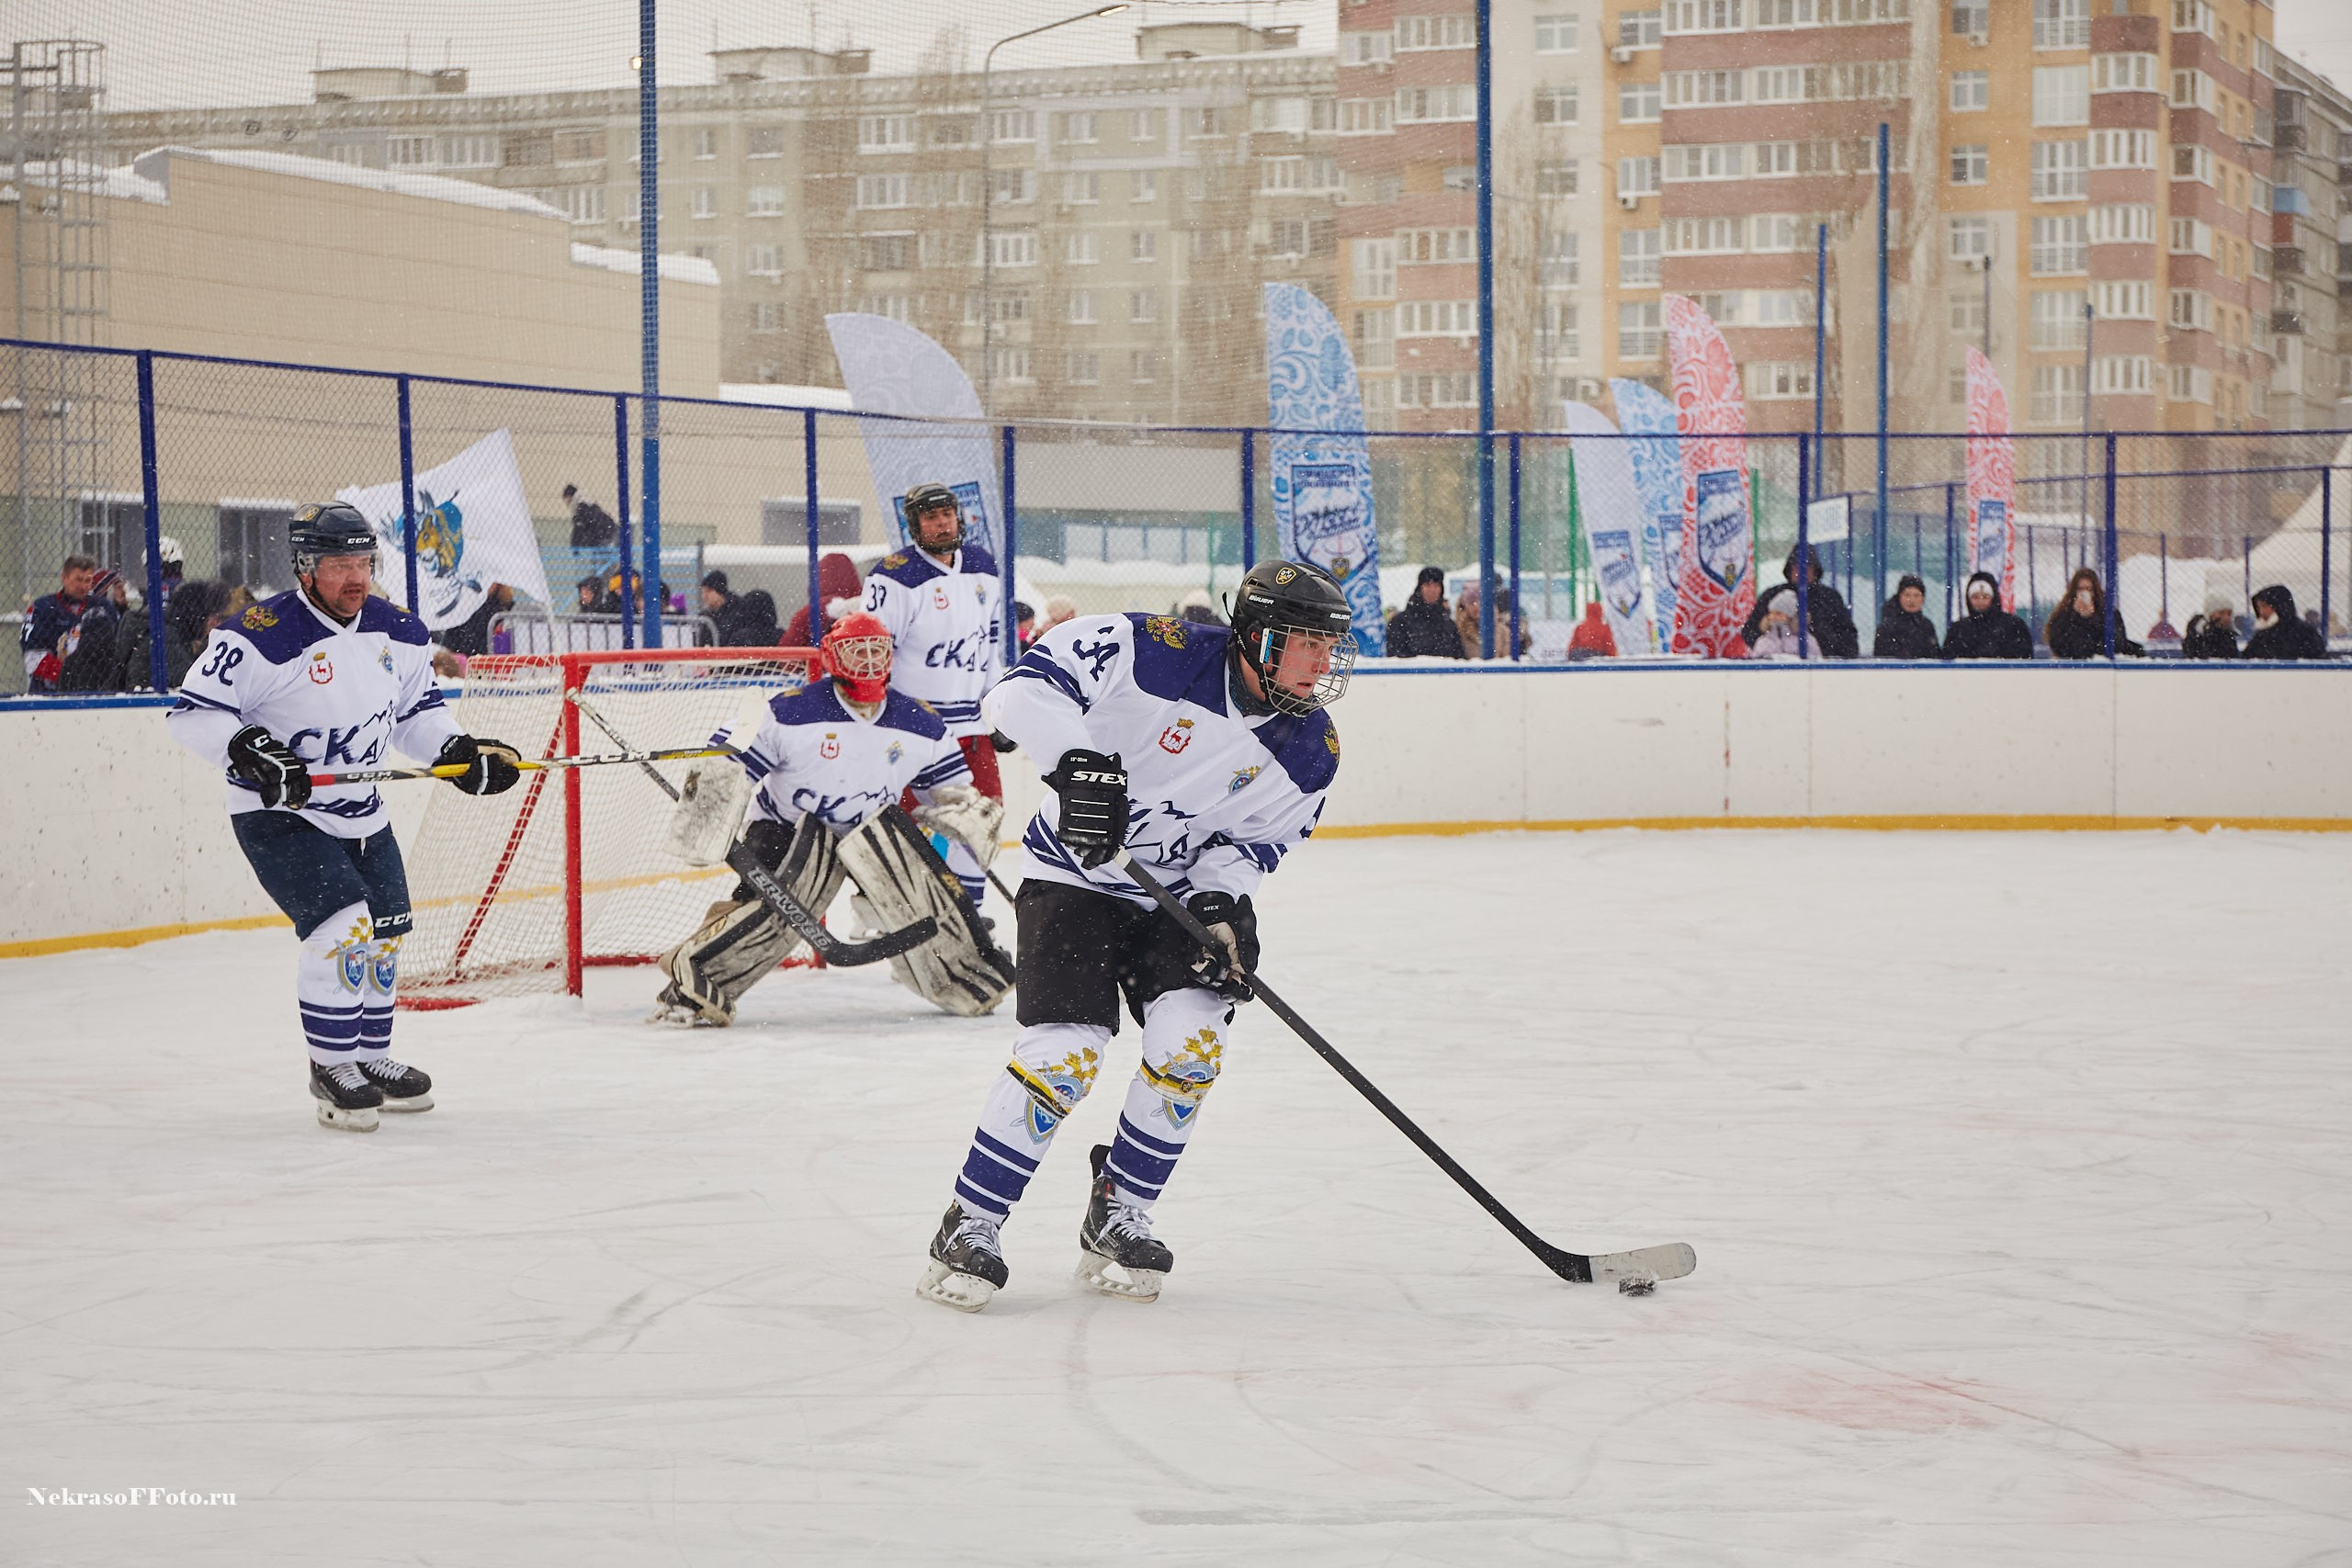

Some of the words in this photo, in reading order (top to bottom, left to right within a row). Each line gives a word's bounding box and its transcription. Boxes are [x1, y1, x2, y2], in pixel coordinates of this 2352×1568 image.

[201, 641, 243, 686] 38
[443, 736, 459, 754] CCM
[346, 771, 392, 780] CCM
[1070, 771, 1127, 786] STEX
